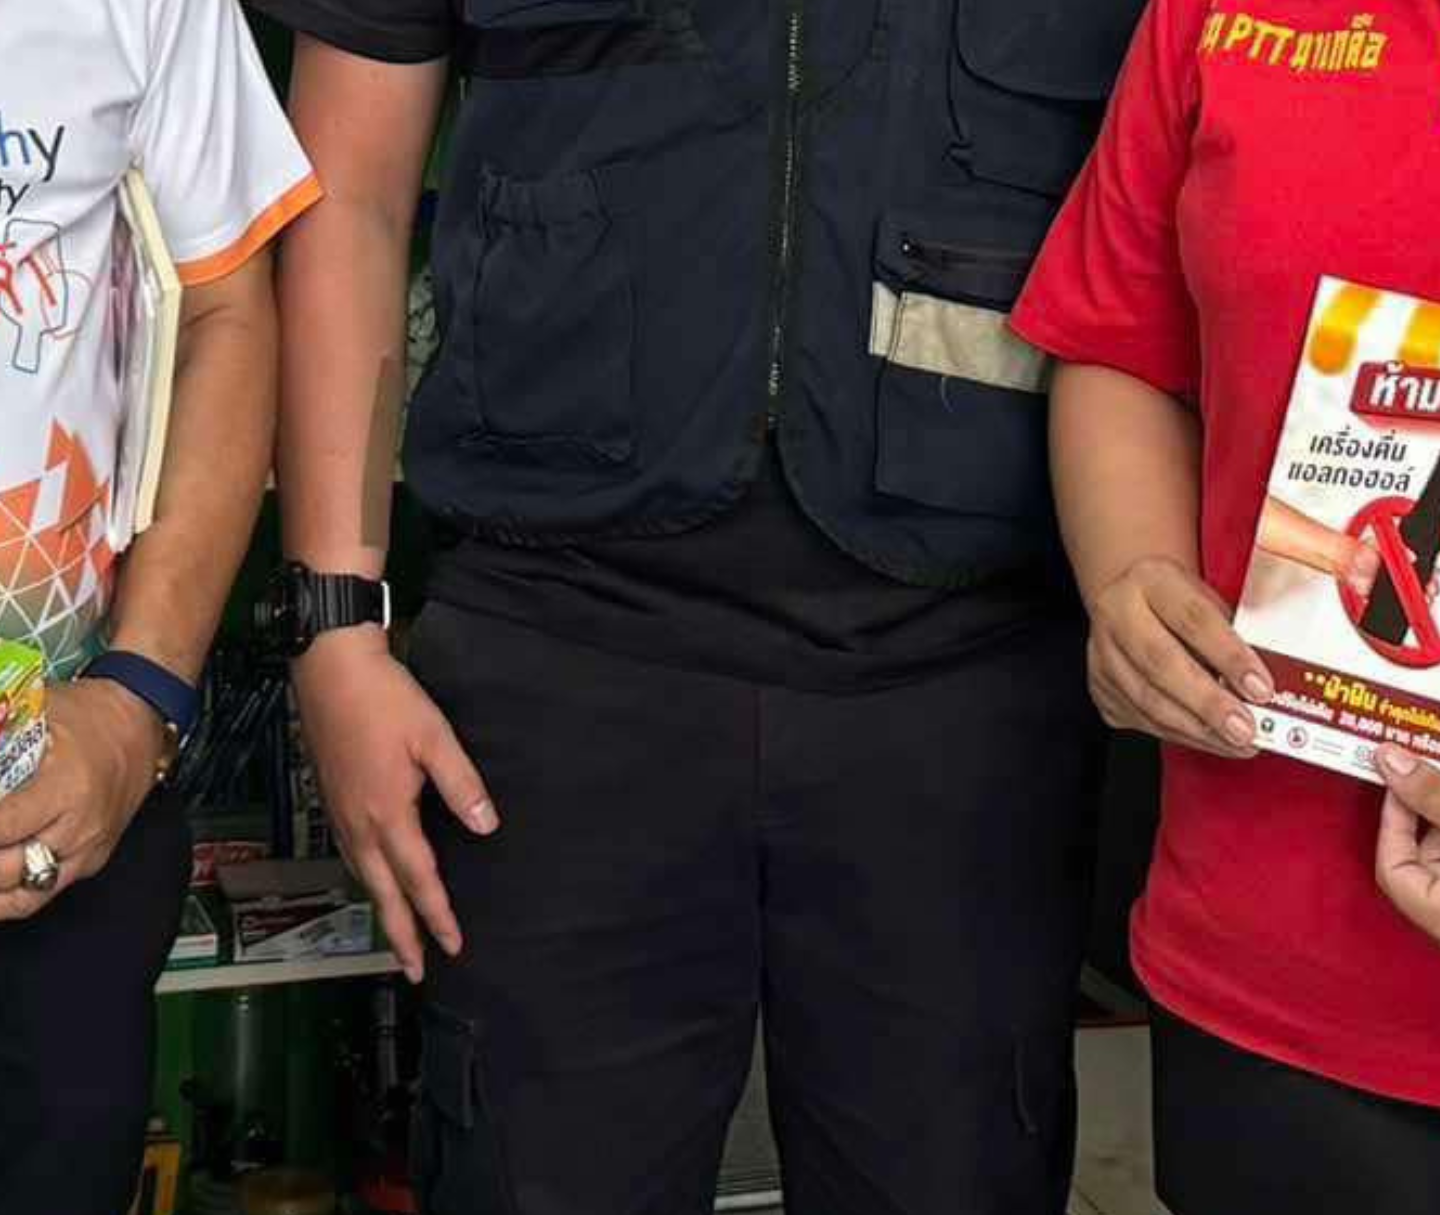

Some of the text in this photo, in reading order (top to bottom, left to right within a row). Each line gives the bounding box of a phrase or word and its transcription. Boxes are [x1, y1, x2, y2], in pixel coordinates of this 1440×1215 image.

[1224, 11, 1295, 65] PTT
[1308, 425, 1409, 463] เครื่องดื่ม
[1287, 459, 1415, 494] แอลกอฮอล์
